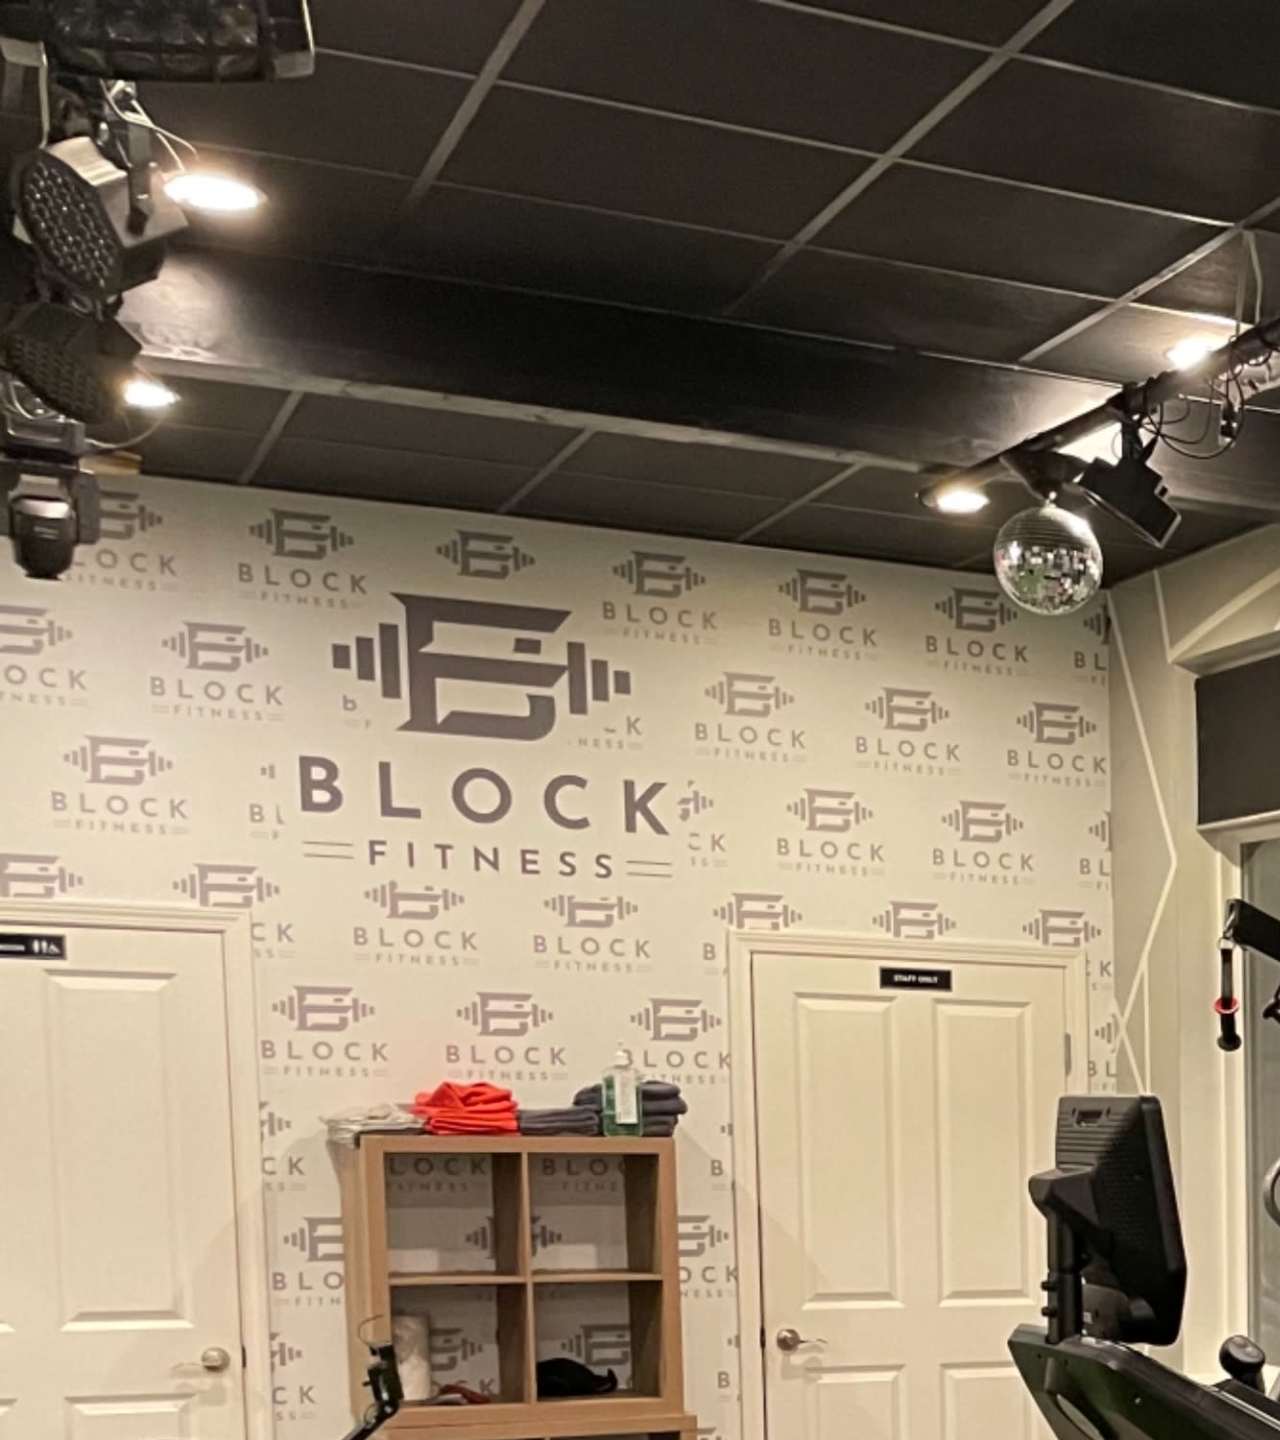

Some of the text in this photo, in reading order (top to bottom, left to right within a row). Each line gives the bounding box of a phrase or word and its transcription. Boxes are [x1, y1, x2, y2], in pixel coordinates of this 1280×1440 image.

[75, 548, 177, 577] OCK
[237, 562, 367, 594] BLOCK
[602, 600, 718, 630] BLOCK
[769, 618, 877, 646] BLOCK
[925, 634, 1029, 663] BLOCK
[3, 664, 88, 691] OCK
[150, 675, 284, 707] BLOCK
[694, 723, 806, 750] BLOCK
[855, 736, 960, 762] BLOCK
[1007, 750, 1107, 774] BLOCK
[50, 790, 189, 820] BLOCK
[299, 755, 671, 837] BLOCK
[368, 840, 613, 879] FITNESS
[776, 837, 886, 863] BLOCK
[932, 848, 1035, 873] BLOCK
[353, 926, 479, 951] BLOCK
[533, 935, 651, 959] BLOCK
[260, 1040, 390, 1062] BLOCK
[445, 1044, 568, 1067] BLOCK
[390, 1157, 487, 1176] LOCK
[271, 1271, 344, 1291] BLO
